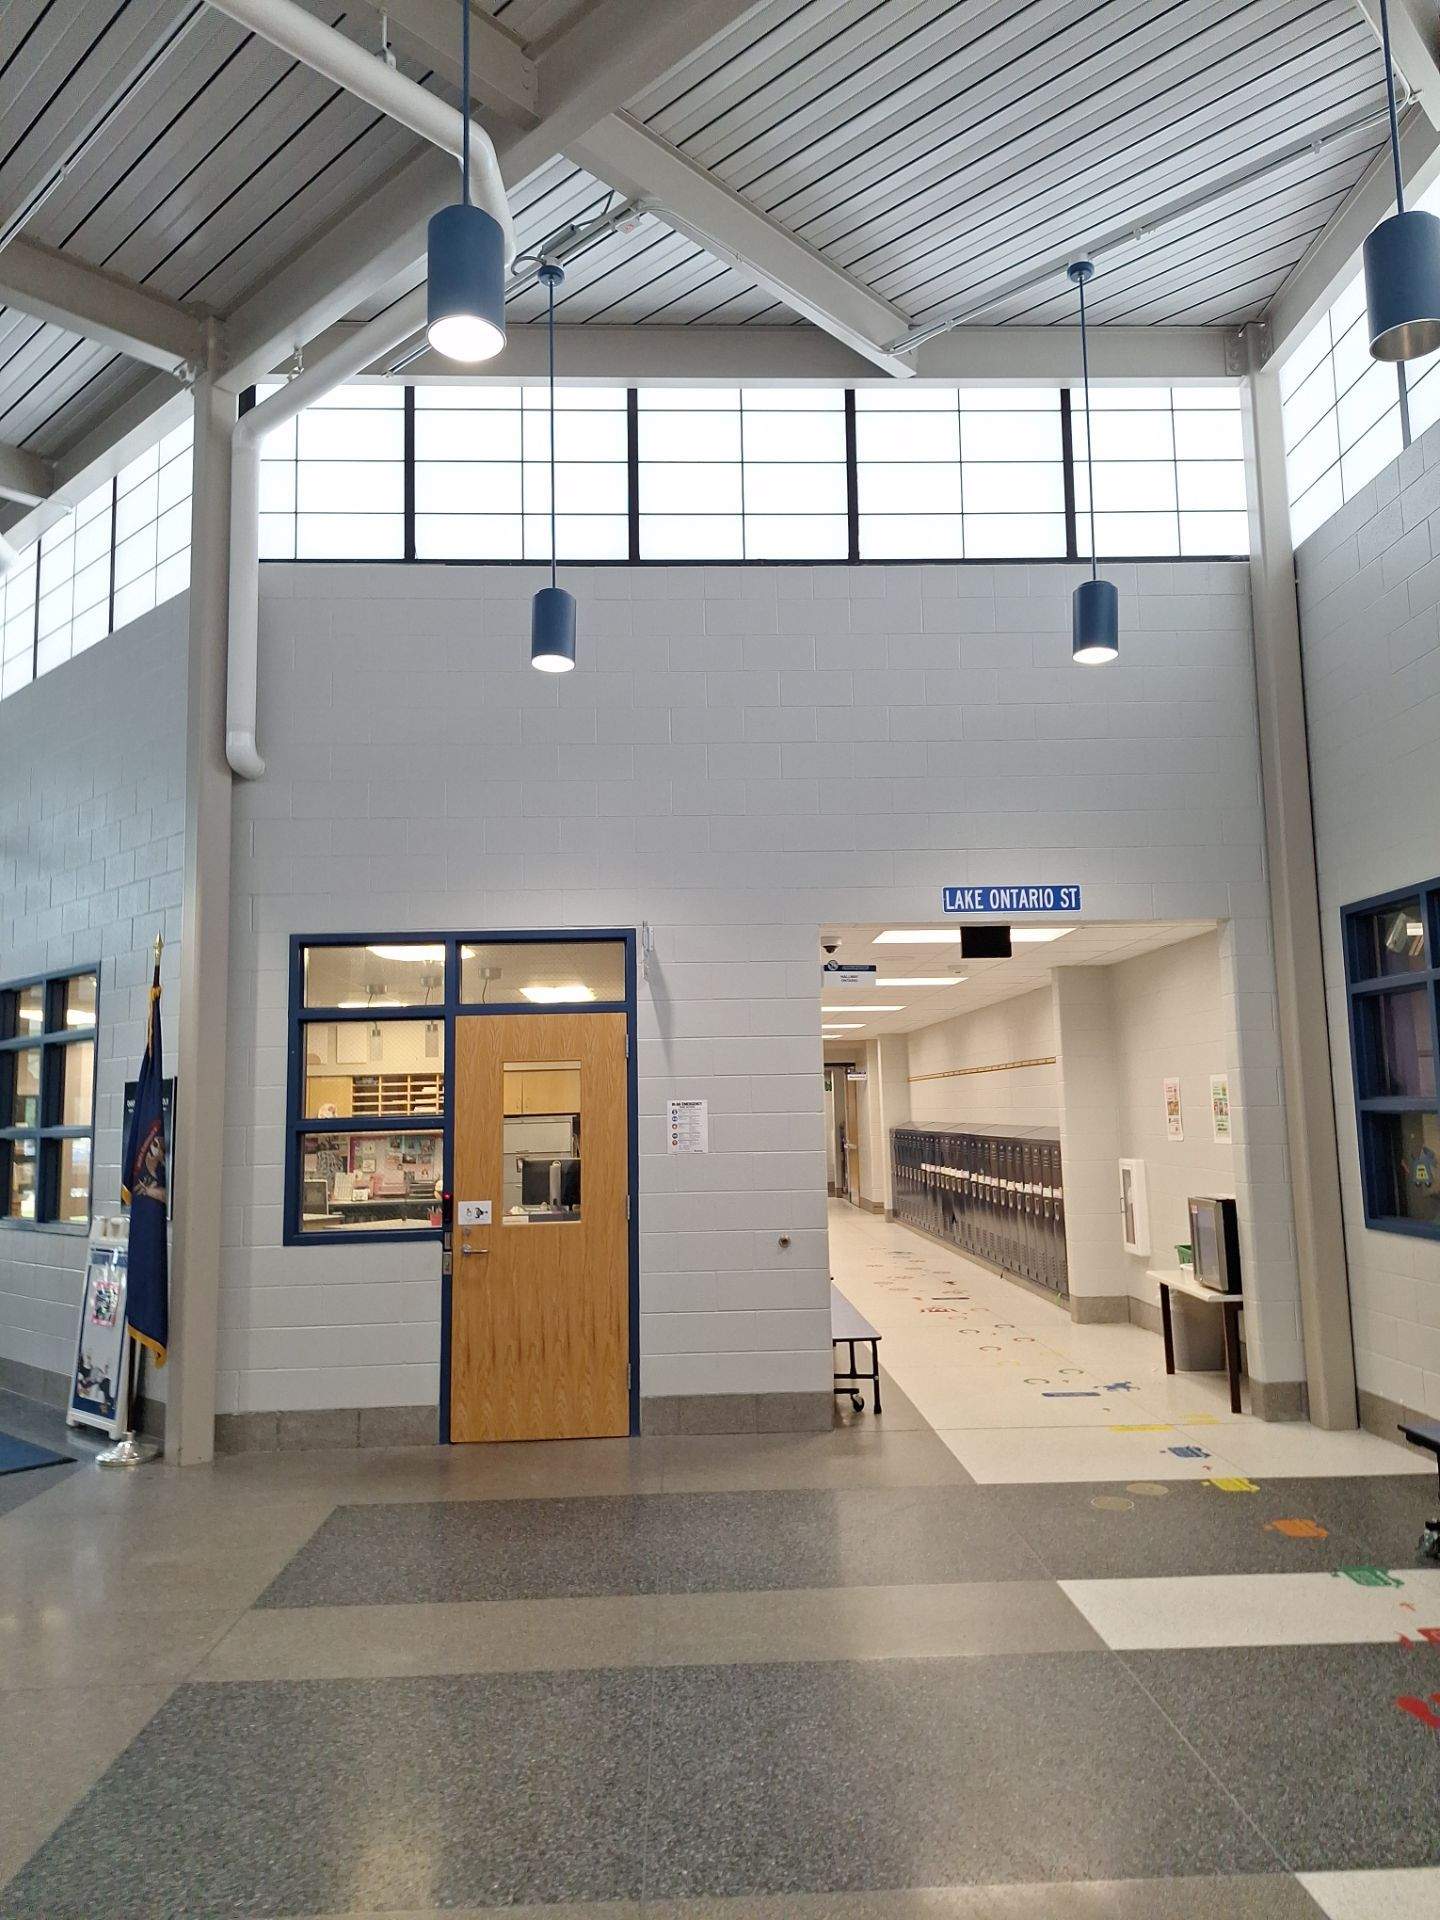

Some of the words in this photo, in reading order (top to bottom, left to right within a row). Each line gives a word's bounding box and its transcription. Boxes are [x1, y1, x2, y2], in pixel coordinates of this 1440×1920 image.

[945, 889, 984, 910] LAKE
[989, 888, 1054, 909] ONTARIO
[1060, 888, 1077, 908] ST
